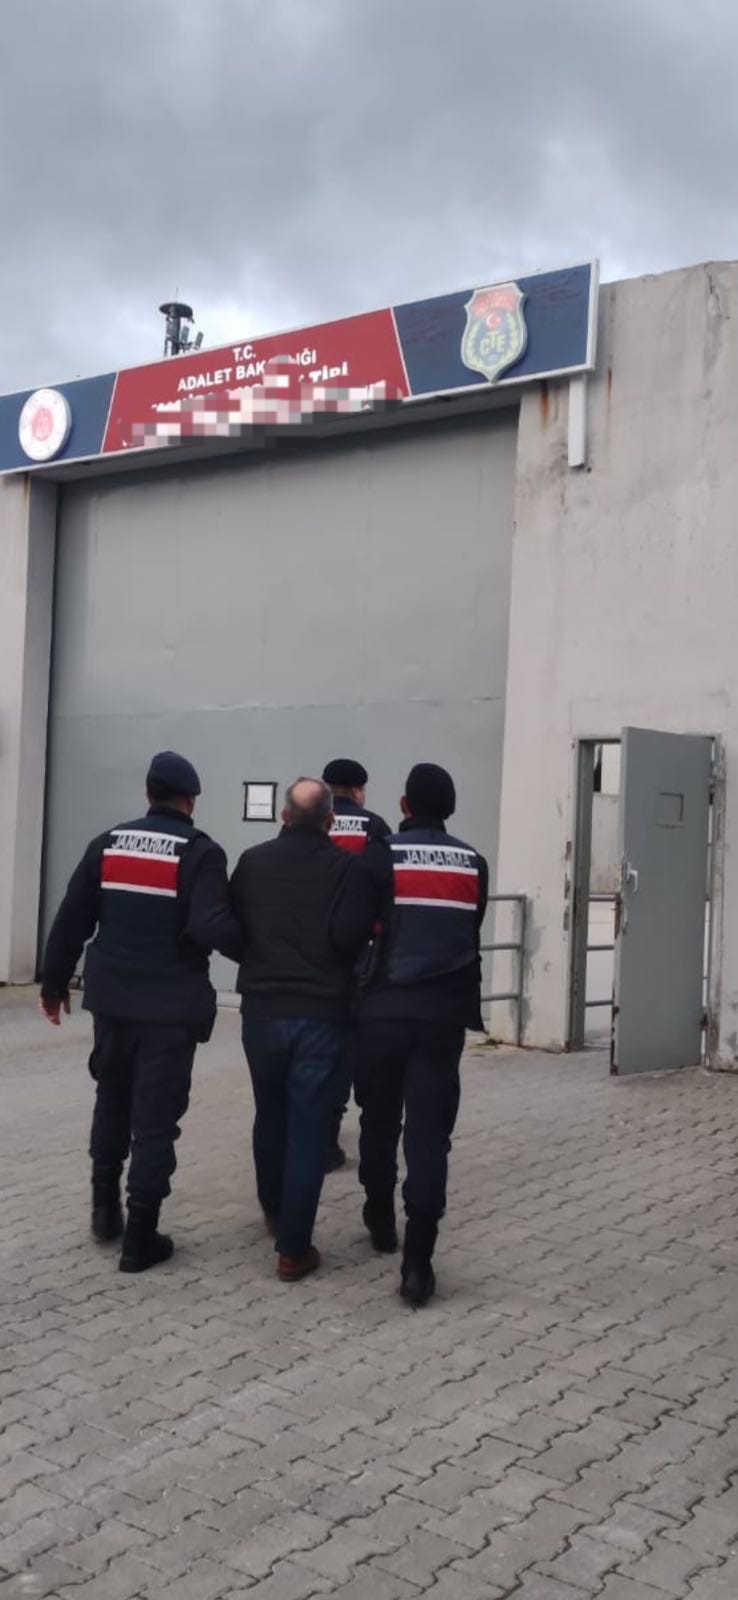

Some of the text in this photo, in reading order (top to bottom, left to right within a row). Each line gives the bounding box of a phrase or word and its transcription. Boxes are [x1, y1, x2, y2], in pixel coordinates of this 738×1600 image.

[232, 345, 257, 362] T.C.
[479, 331, 506, 355] CTE
[177, 347, 317, 392] ADALET BAKIĞI
[111, 834, 177, 856] JANDARMA
[403, 850, 472, 868] JANDARMA
